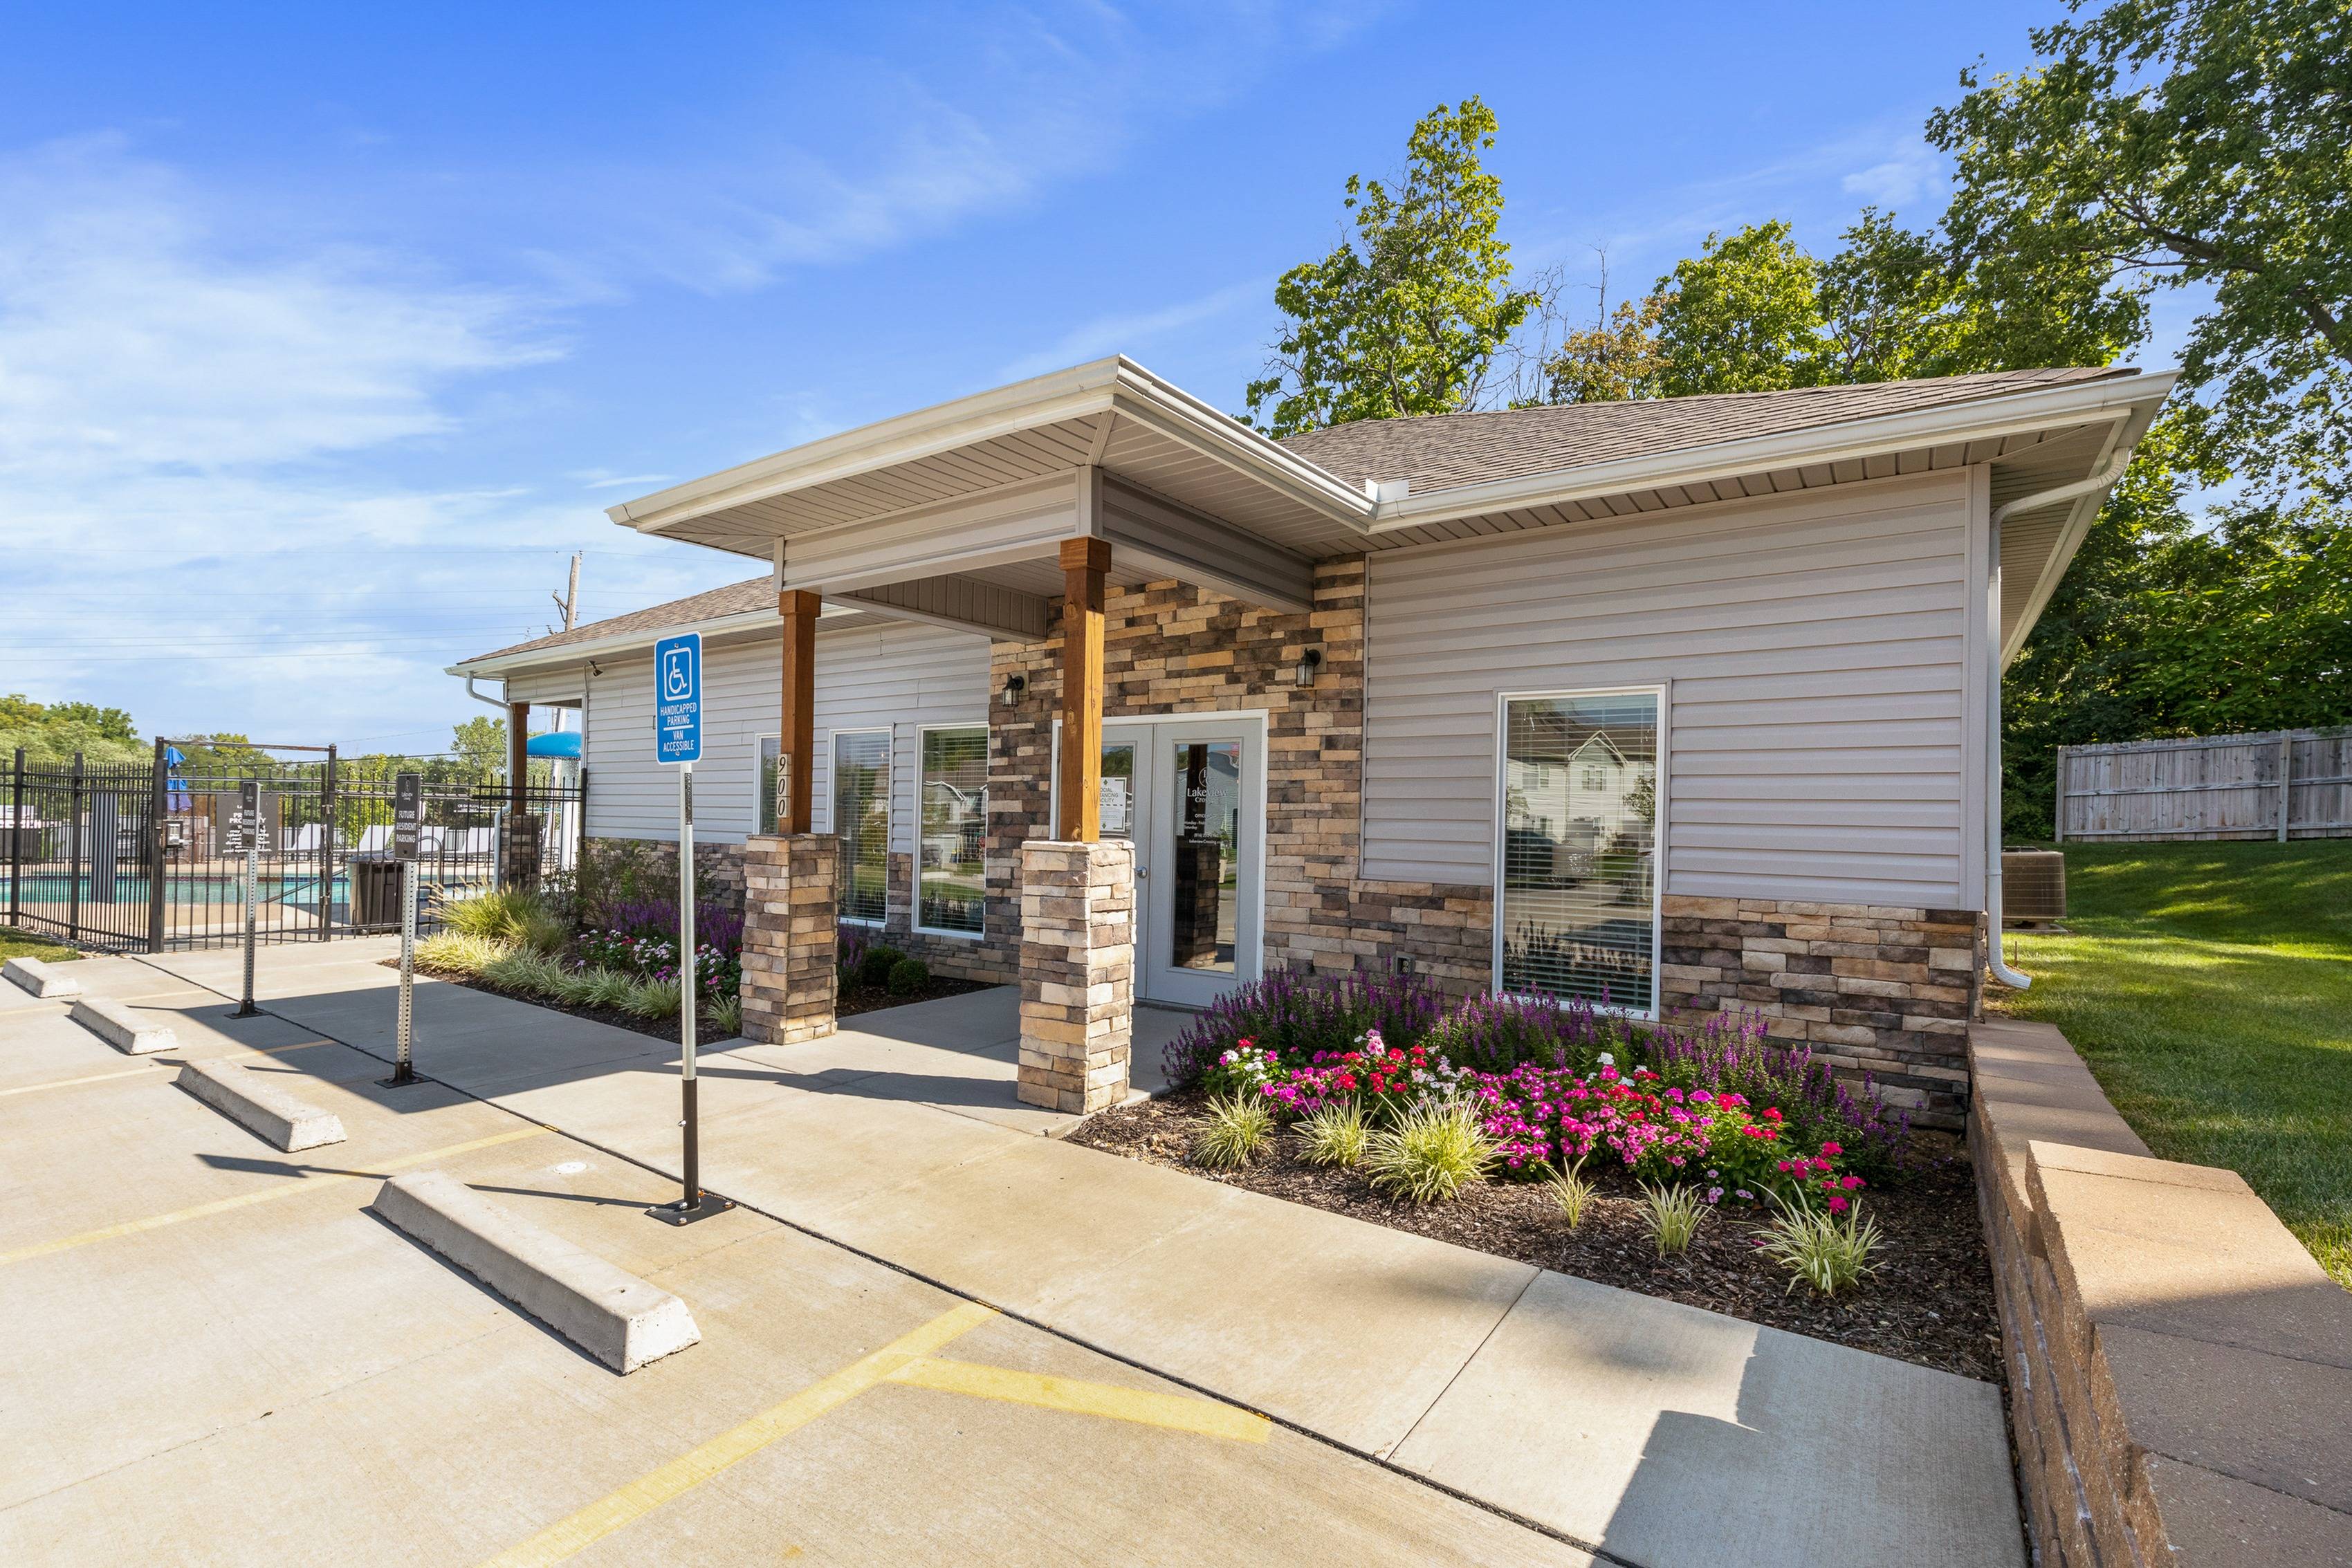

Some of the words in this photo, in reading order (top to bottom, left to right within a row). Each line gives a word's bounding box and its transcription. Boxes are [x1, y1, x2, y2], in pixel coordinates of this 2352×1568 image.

[660, 702, 697, 717] HANDICAPPED
[667, 714, 690, 726] PARKING
[672, 730, 683, 741] VAN
[663, 739, 695, 753] ACCESSIBLE
[398, 810, 415, 819] FUTURE
[396, 822, 416, 831] RESIDENT
[396, 833, 416, 842] PARKING
